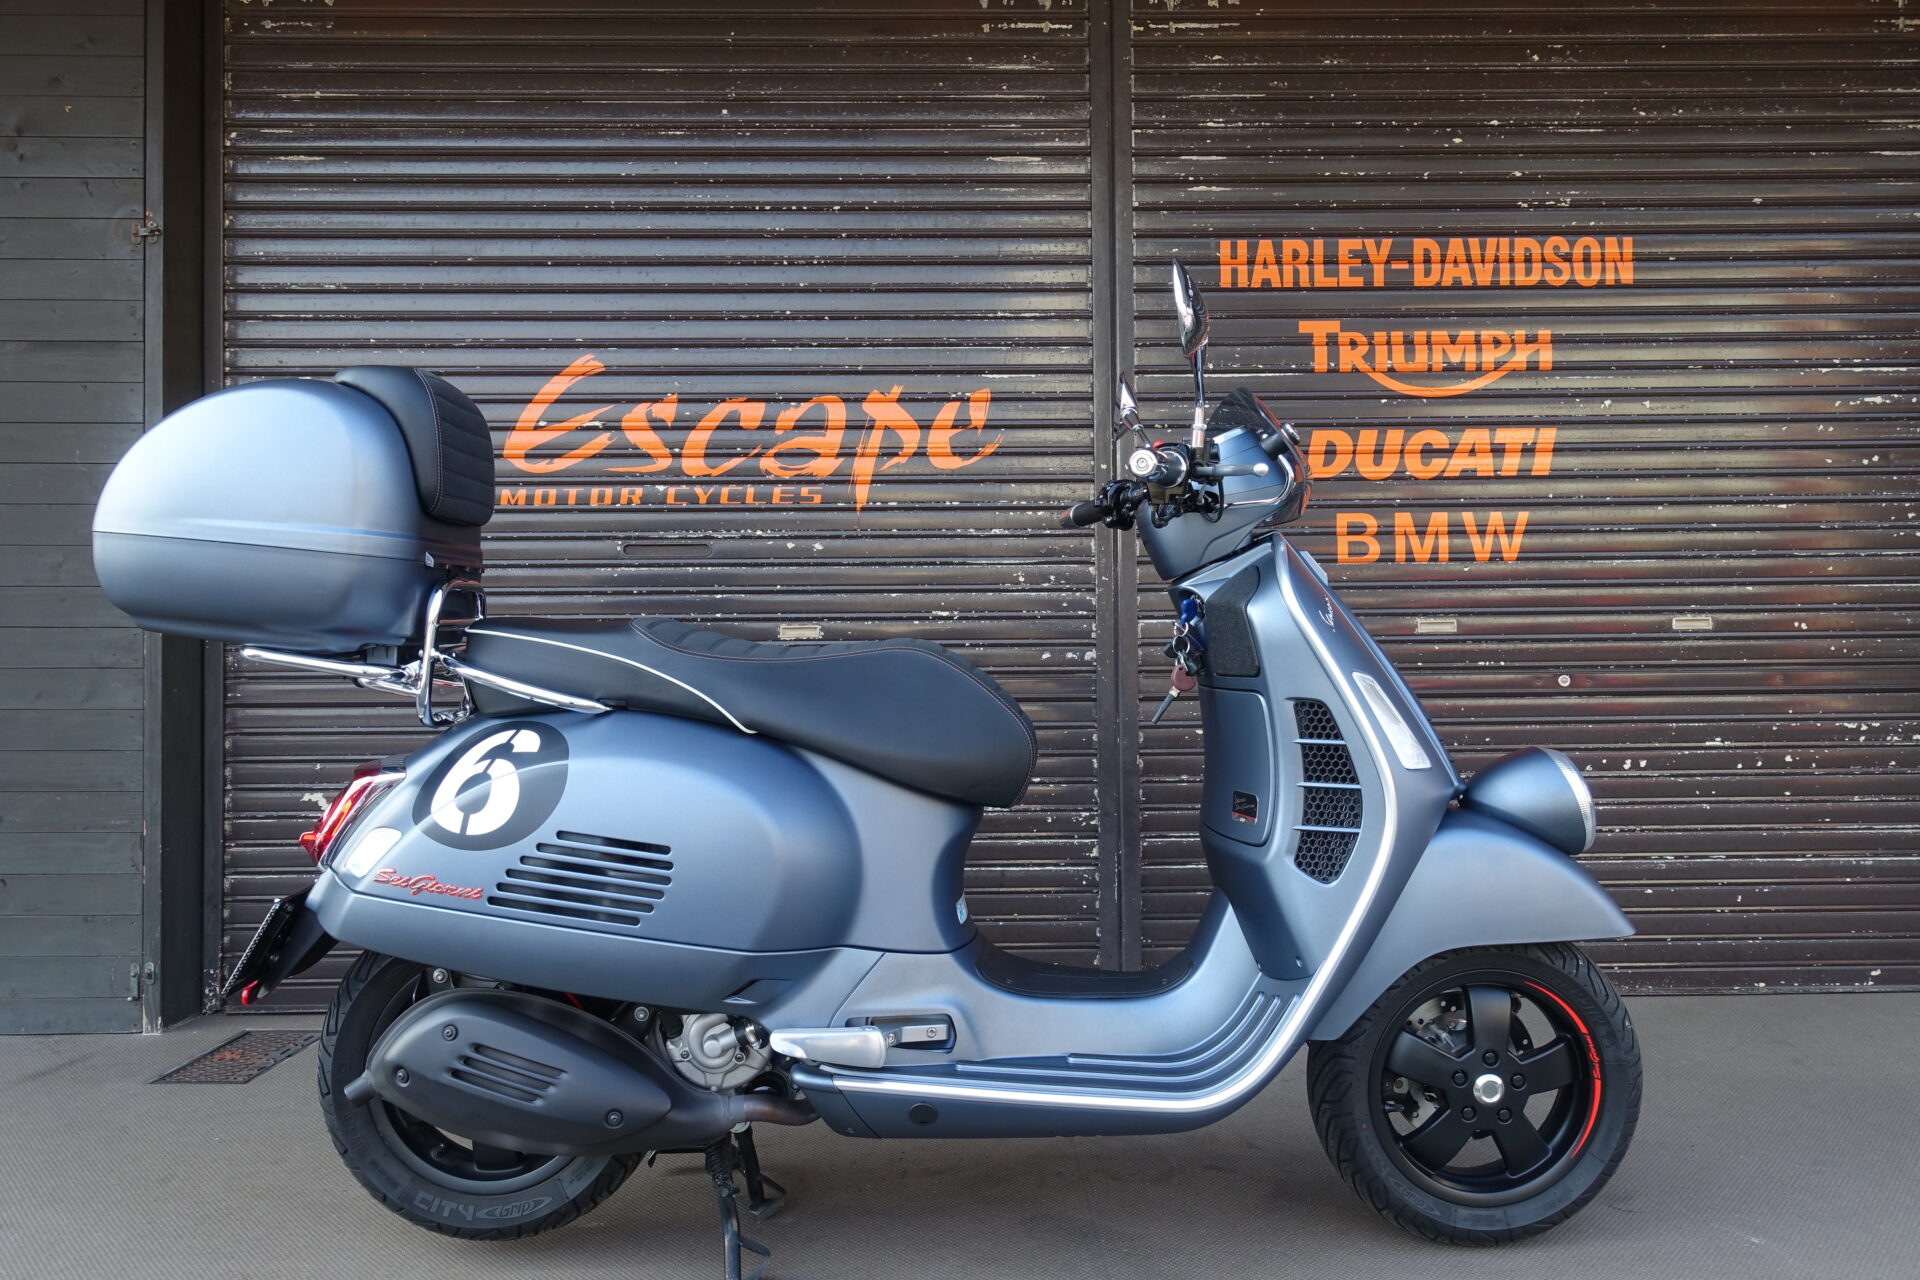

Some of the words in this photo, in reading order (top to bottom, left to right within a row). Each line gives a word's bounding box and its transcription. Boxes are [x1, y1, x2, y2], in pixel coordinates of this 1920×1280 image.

[1219, 236, 1635, 288] HARLEY-DAVIDSON
[1298, 320, 1553, 397] TRIUMPH
[499, 353, 1002, 515] Escape
[1305, 427, 1558, 481] DUCATI
[499, 487, 643, 506] MOTOR
[666, 486, 823, 505] CYCLES
[1335, 511, 1529, 564] BMW
[430, 729, 541, 836] 6
[413, 1190, 475, 1221] CITY
